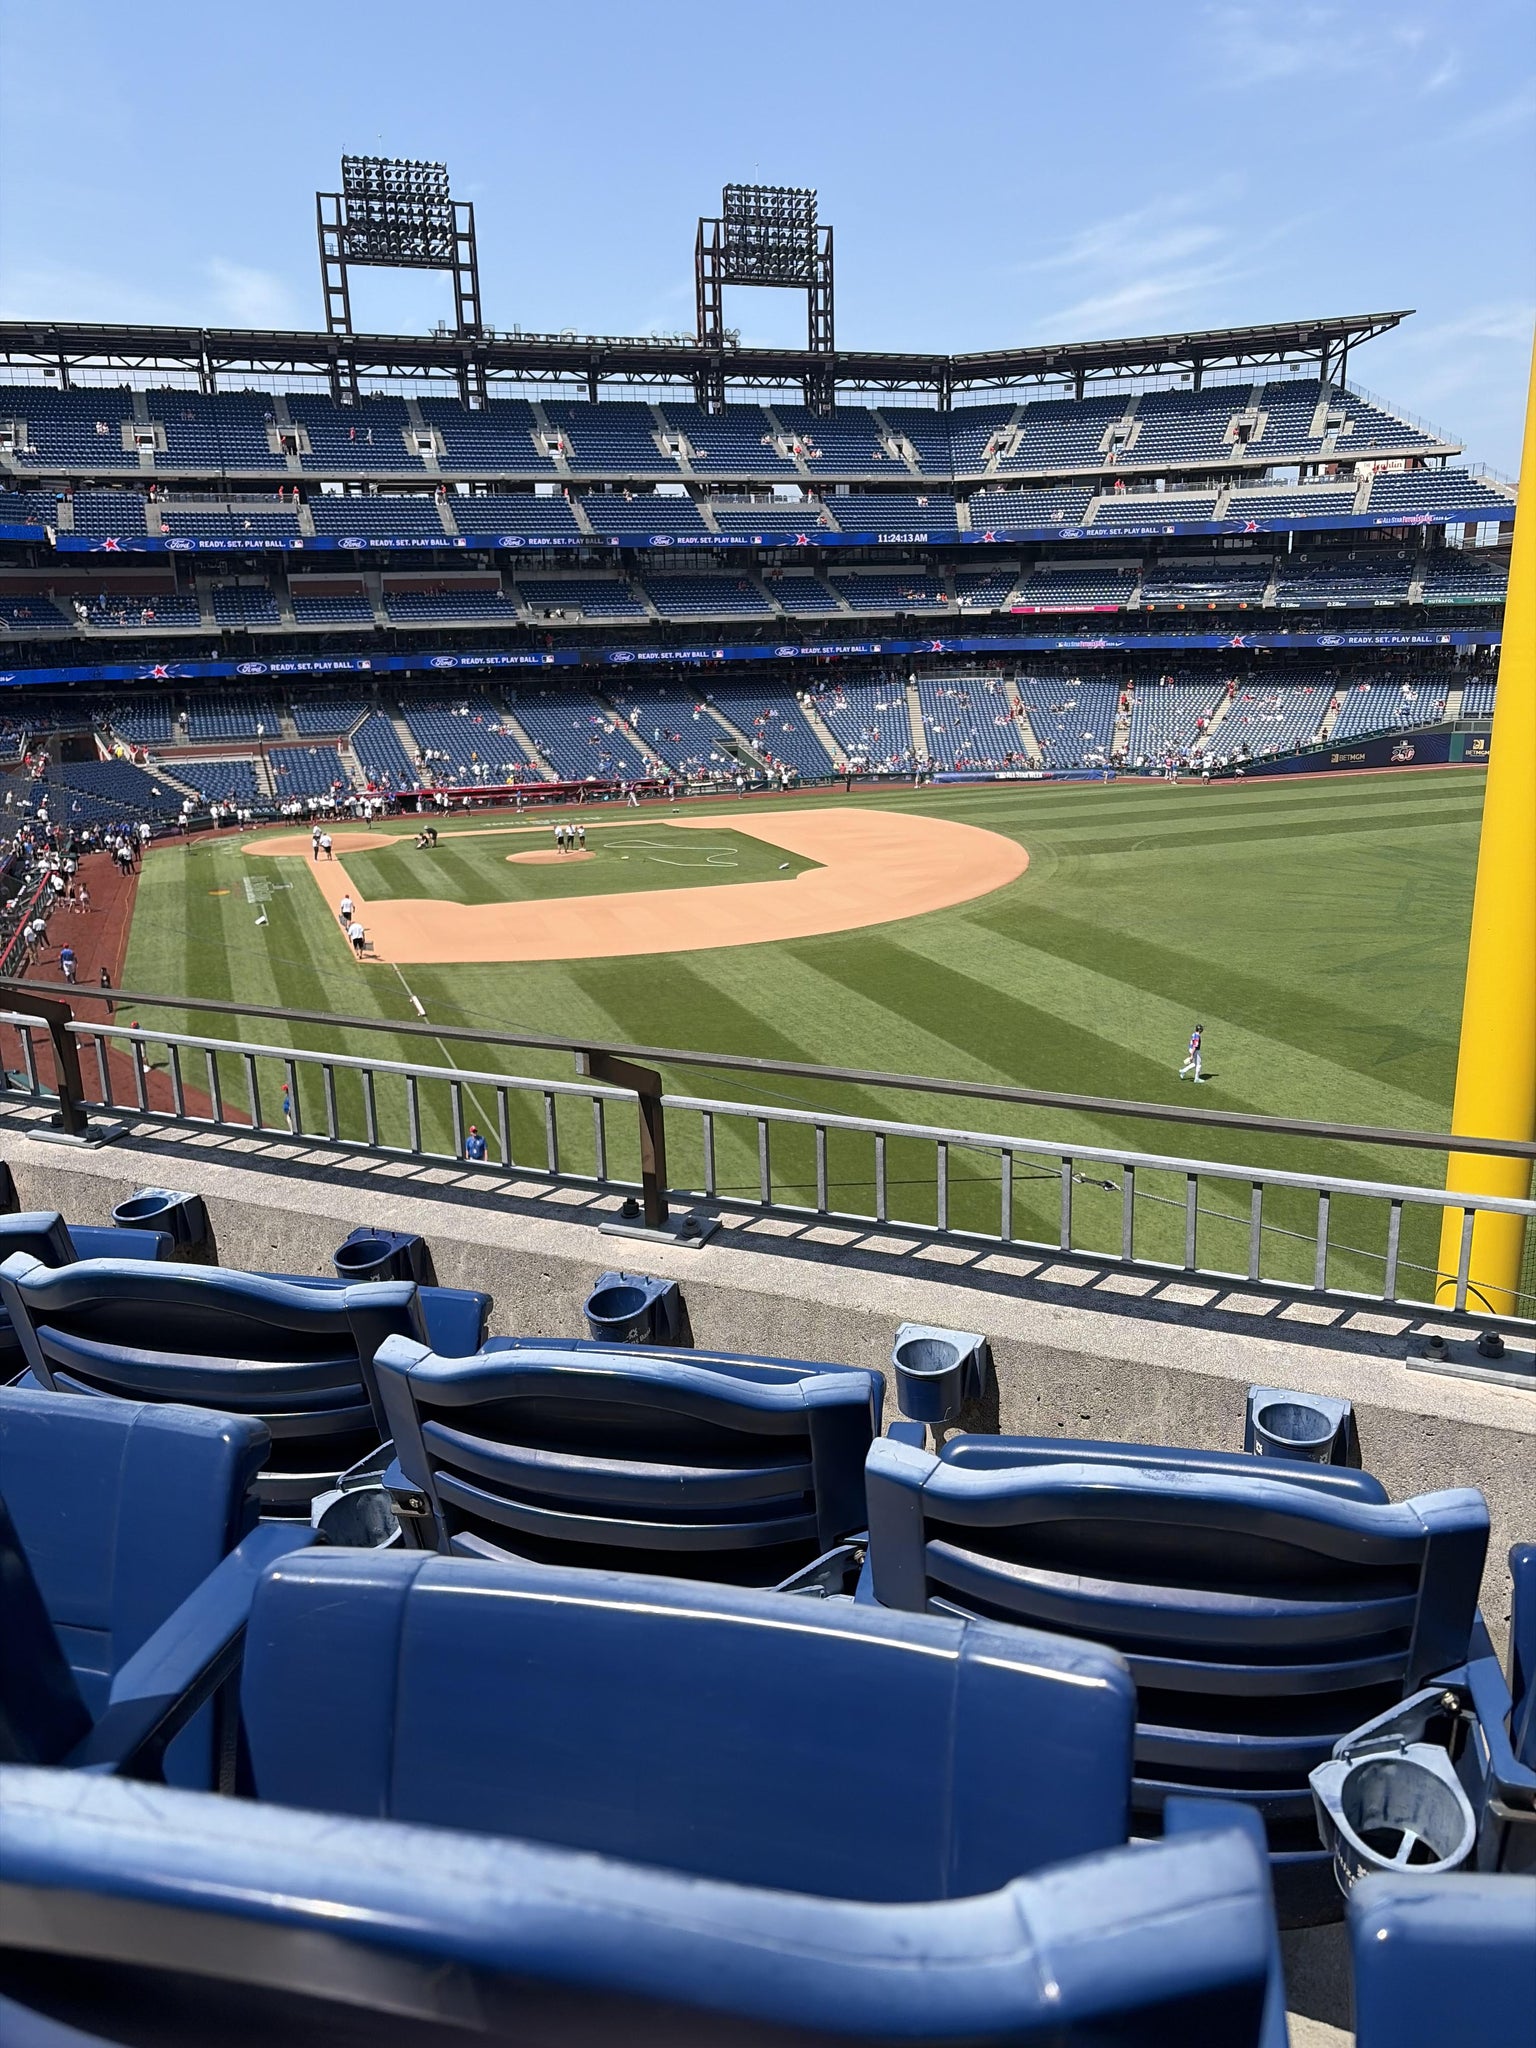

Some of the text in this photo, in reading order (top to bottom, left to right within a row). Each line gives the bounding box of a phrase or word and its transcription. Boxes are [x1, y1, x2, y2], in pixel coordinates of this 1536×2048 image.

[1062, 529, 1080, 538] Ford
[1086, 529, 1108, 537] READY.
[1141, 526, 1159, 534] BALL.
[342, 539, 363, 548] Ford
[370, 539, 395, 547] READY.
[396, 539, 411, 547] SET.
[430, 538, 450, 546] BALL.
[502, 538, 522, 547] Ford
[653, 537, 672, 546] Ford
[878, 533, 928, 543] 11:24:13 AM
[169, 540, 191, 550] Ford
[1321, 636, 1341, 645] Ford
[1348, 636, 1373, 644] READY.
[1411, 635, 1432, 643] BALL.
[613, 652, 632, 661] Ford
[637, 652, 660, 660] READY.
[778, 647, 796, 656] Ford
[435, 657, 454, 667] Ford
[241, 664, 263, 673] Ford
[270, 663, 296, 671] READY.
[314, 662, 332, 670] PLAY
[1338, 753, 1366, 762] BETMGM
